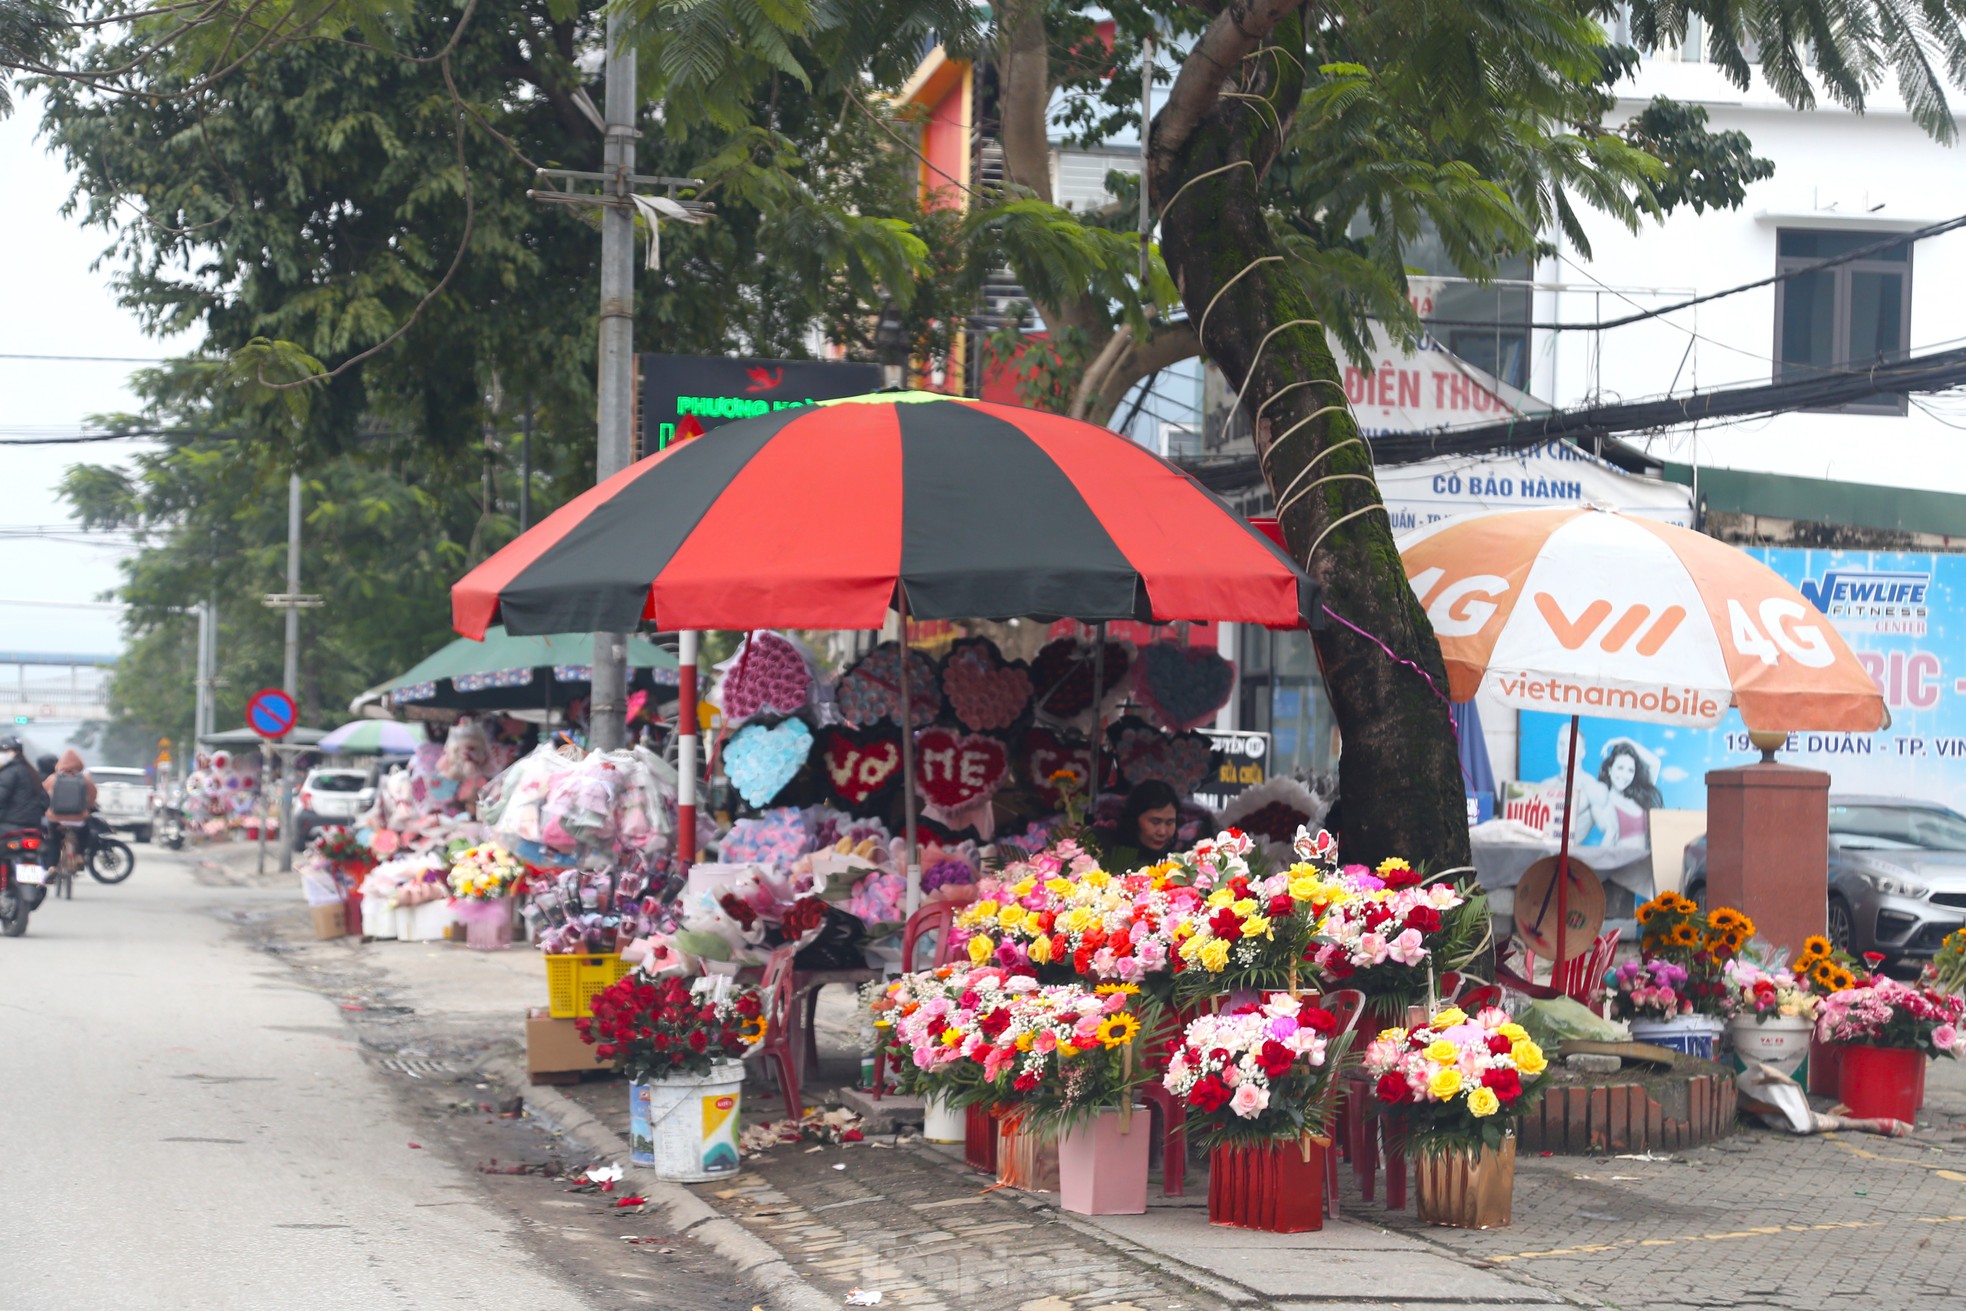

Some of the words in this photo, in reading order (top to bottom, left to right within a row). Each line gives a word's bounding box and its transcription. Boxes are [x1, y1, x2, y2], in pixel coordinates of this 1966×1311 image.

[1344, 359, 1421, 416] ĐIỆN
[1470, 471, 1513, 497] BẢO
[1521, 474, 1582, 500] HÀNH
[1801, 573, 1930, 614] NEWLIFE
[1833, 605, 1927, 618] FITNESS
[1727, 597, 1836, 669] 4G
[1875, 620, 1926, 634] CENTER
[1499, 672, 1719, 719] vietnamobile
